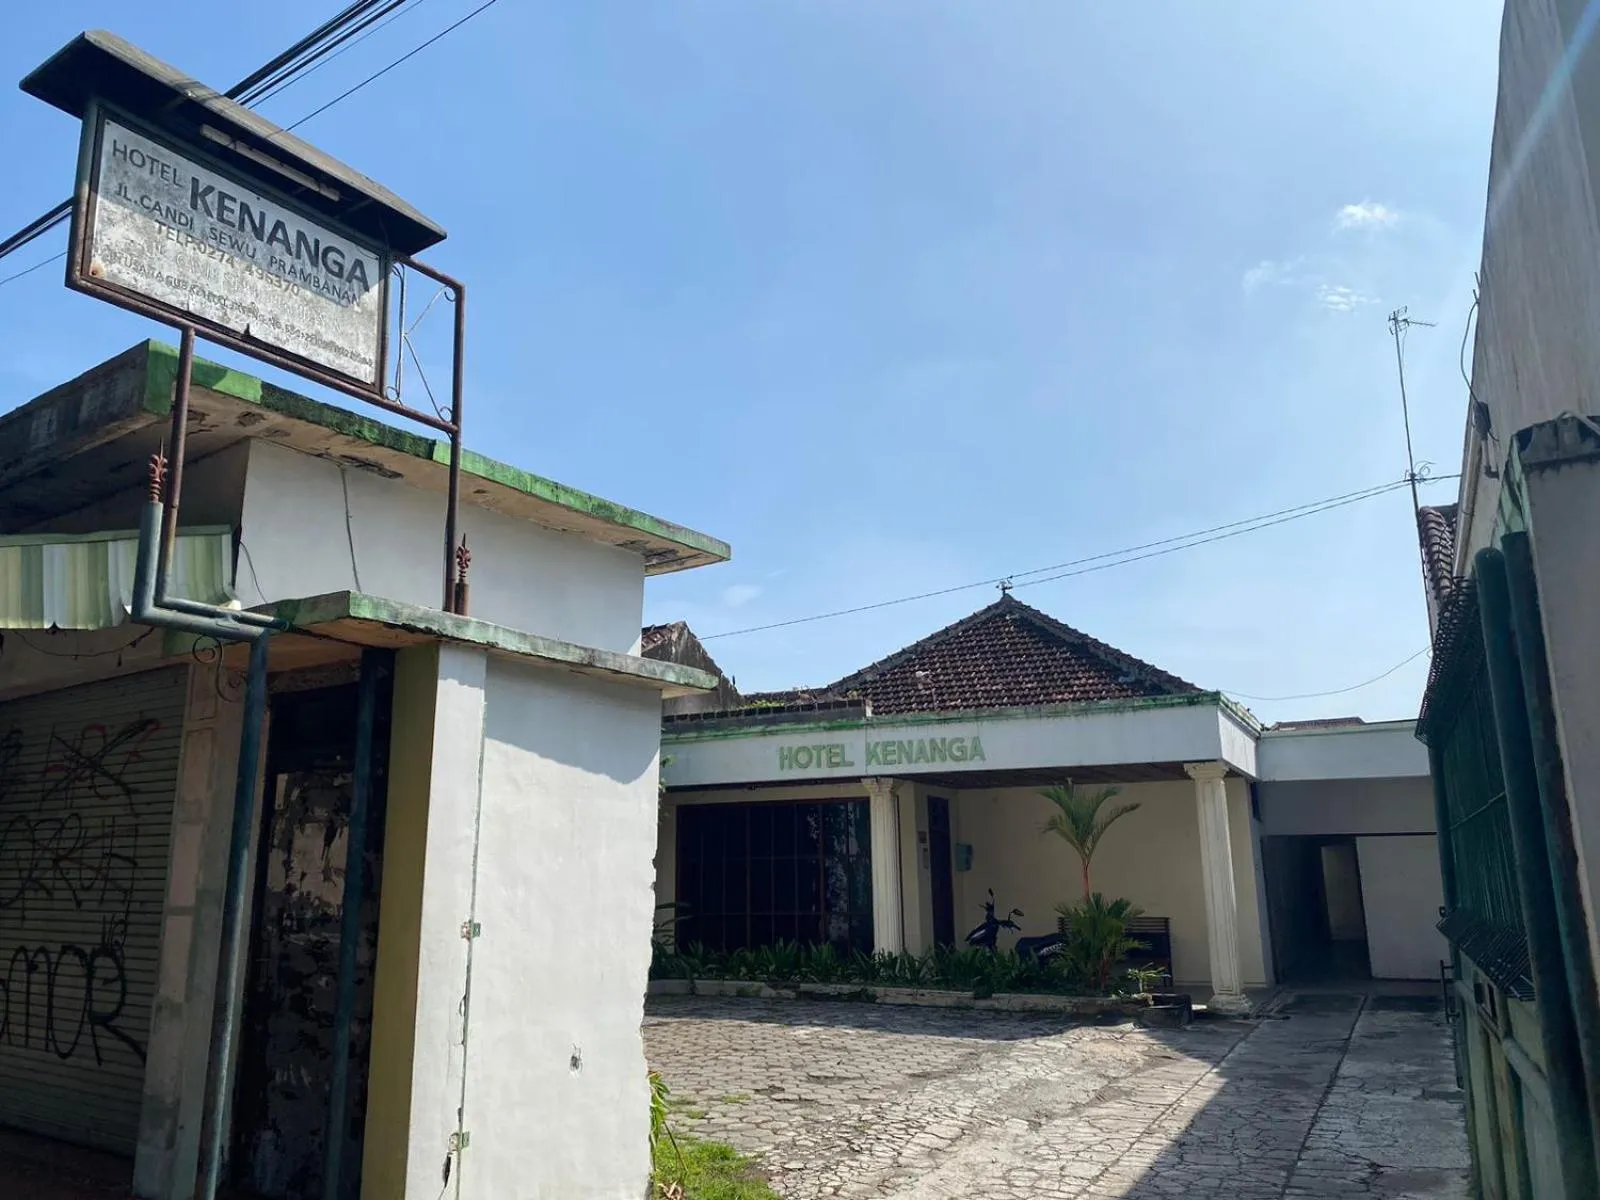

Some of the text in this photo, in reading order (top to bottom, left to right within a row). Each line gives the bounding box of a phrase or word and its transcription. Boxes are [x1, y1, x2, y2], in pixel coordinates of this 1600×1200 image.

[112, 139, 183, 188] HOTEL
[189, 176, 370, 293] KENANGA
[209, 226, 257, 260] SEWU
[270, 255, 361, 308] PRAMBANAN
[779, 736, 986, 771] HOTEL KENANGA
